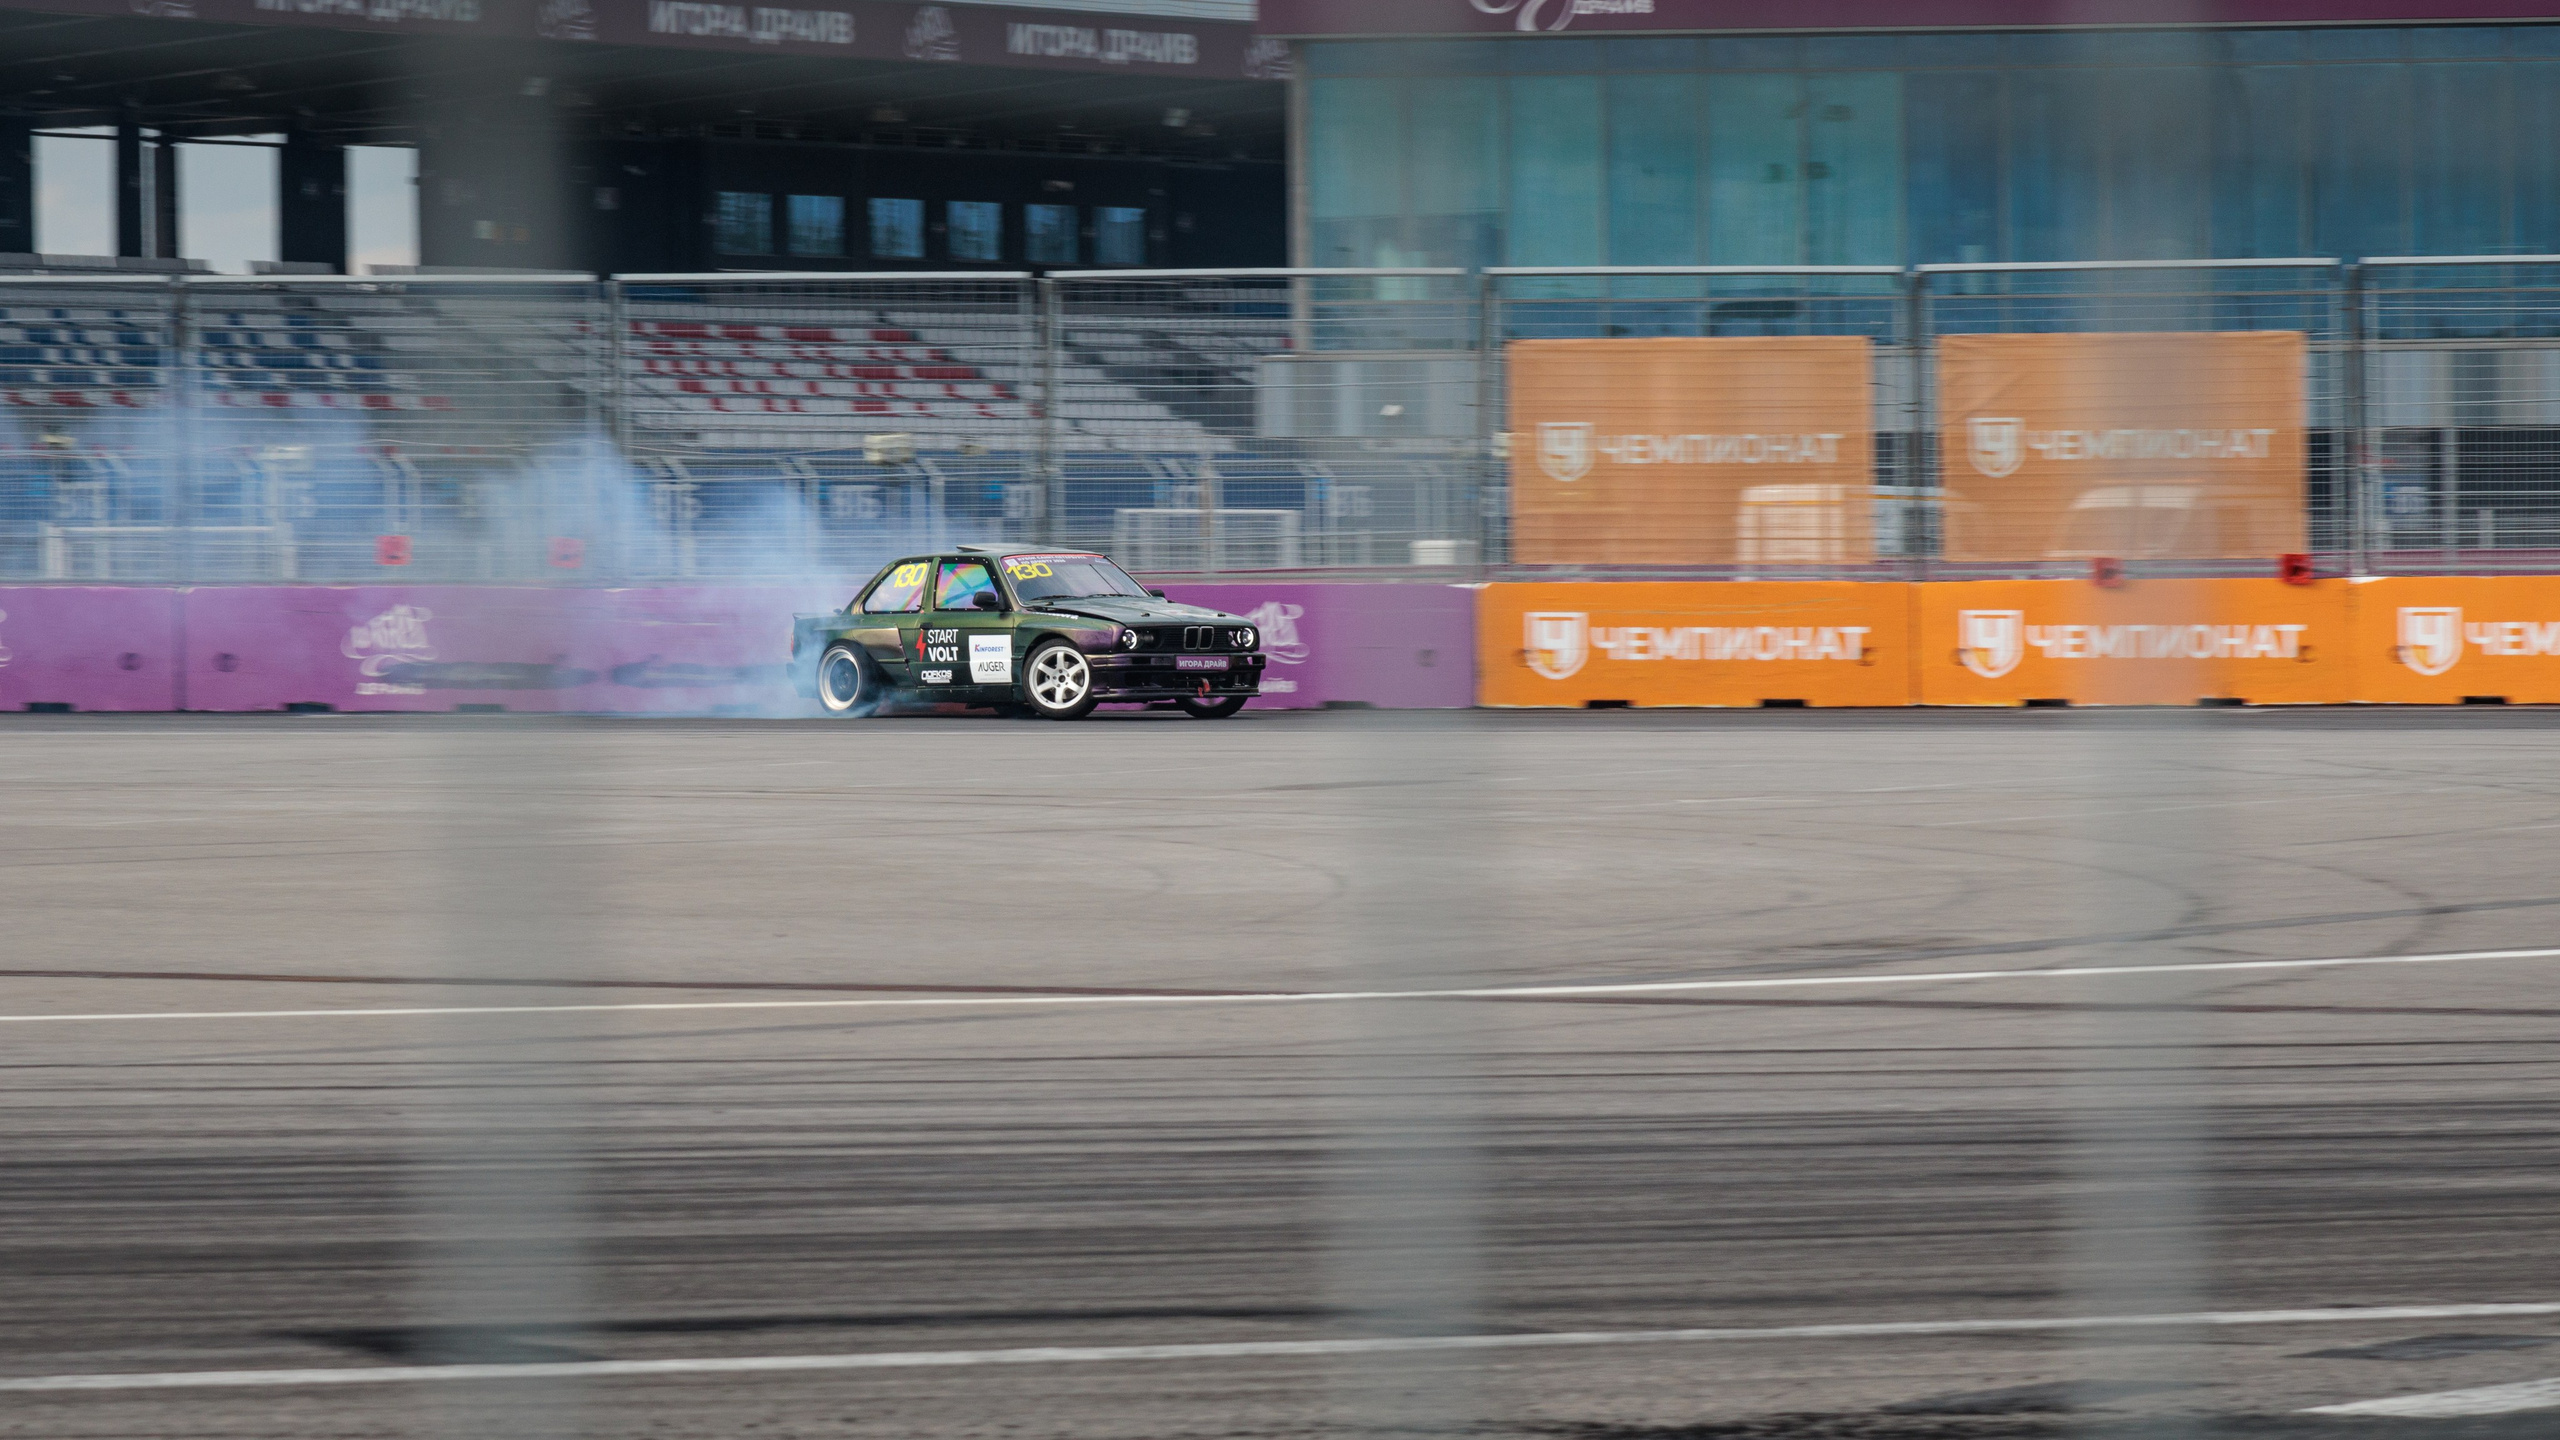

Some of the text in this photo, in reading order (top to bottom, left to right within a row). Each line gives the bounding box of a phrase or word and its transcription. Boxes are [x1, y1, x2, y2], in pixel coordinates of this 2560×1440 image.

[1599, 433, 1844, 464] ЧЕМПИОНАТ
[2027, 428, 2276, 459] ЧЕМПИОНАТ
[894, 563, 928, 588] 130
[1006, 562, 1053, 581] 130
[927, 629, 959, 644] START
[1590, 626, 1871, 660] ЧЕМПИОНАТ
[2025, 624, 2307, 658] ЧЕМПИОНАТ
[927, 646, 959, 662] VOLT
[974, 644, 1004, 652] KINFOREST
[978, 661, 1006, 672] AUGER
[1204, 659, 1227, 668] ДРАЙВ
